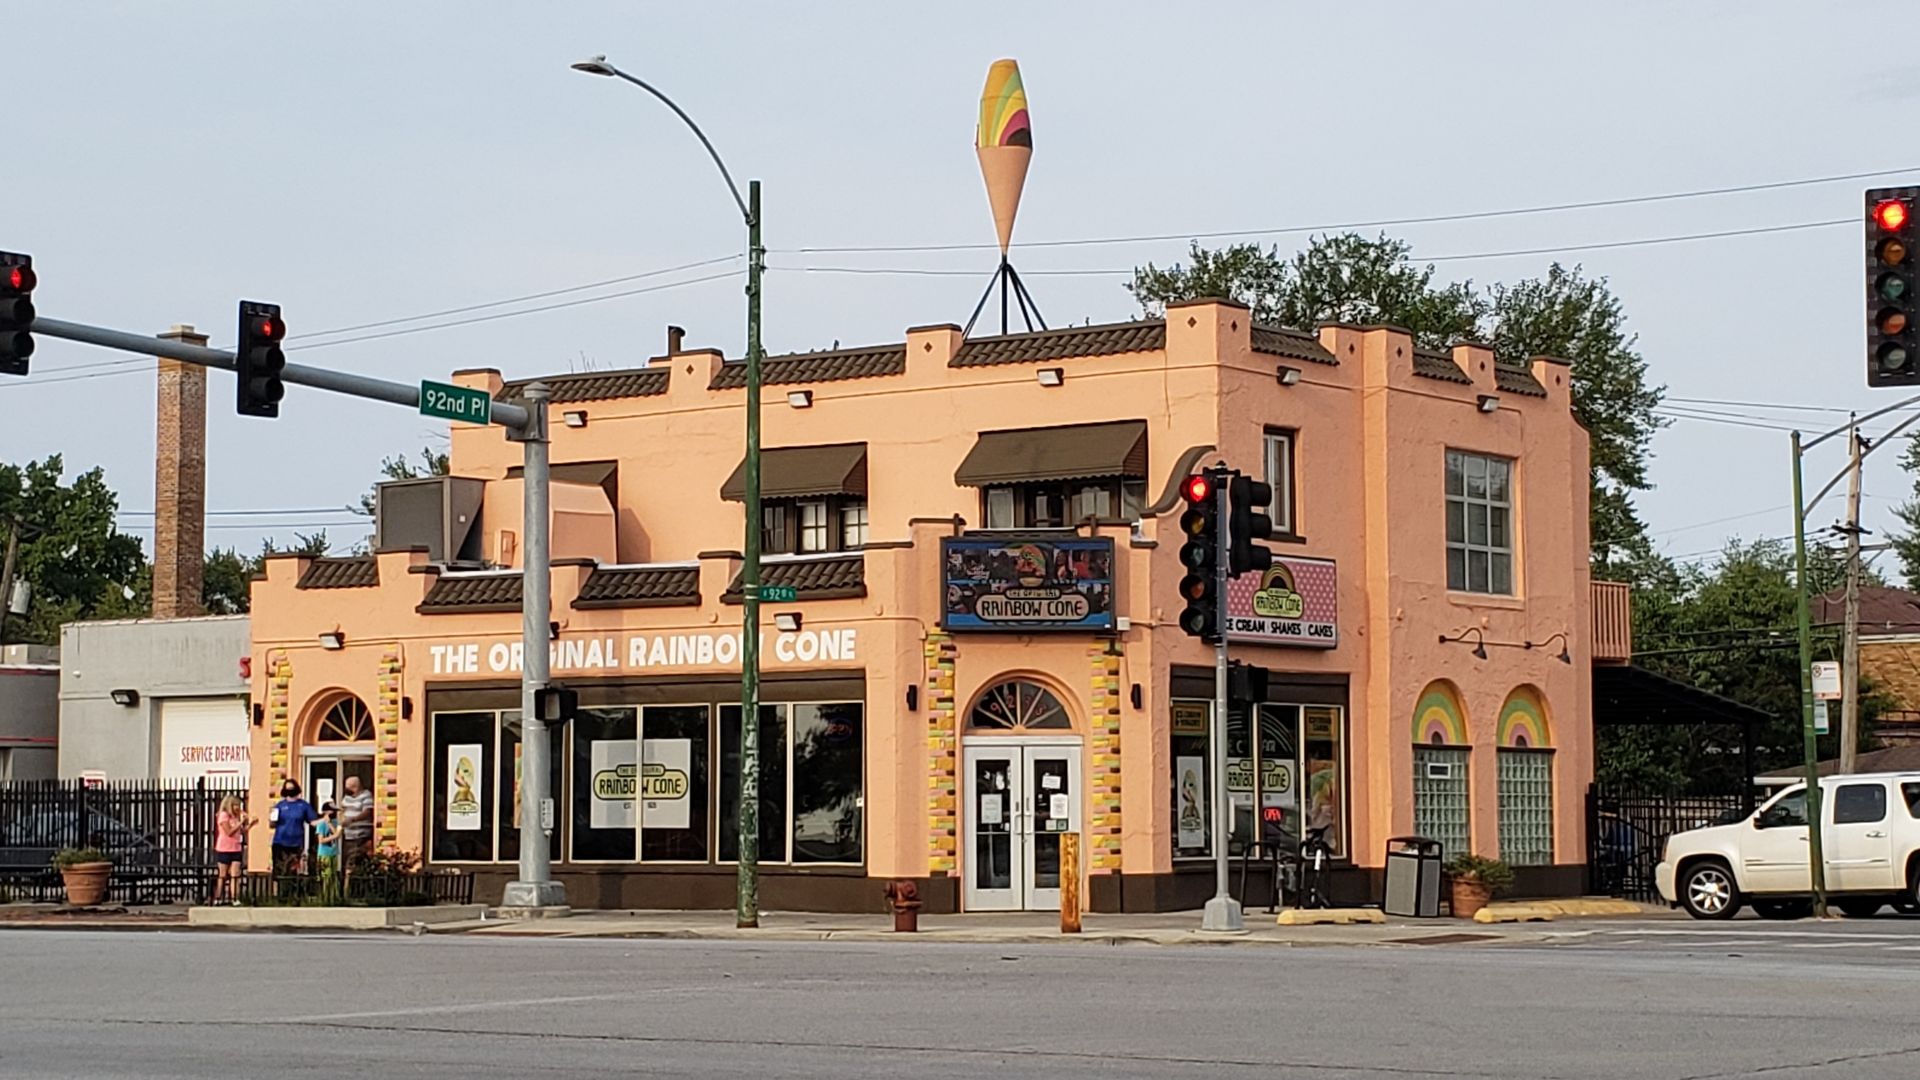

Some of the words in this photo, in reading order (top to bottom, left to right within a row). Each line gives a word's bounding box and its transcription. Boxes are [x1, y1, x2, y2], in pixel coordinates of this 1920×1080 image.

[426, 389, 466, 413] 92nd
[471, 397, 485, 417] Pl
[982, 601, 1041, 616] RAINBOW
[1047, 601, 1084, 616] CONE
[1236, 619, 1265, 633] CREAM
[1270, 621, 1301, 635] SHAKES
[1308, 624, 1333, 637] CAKES
[430, 644, 479, 673] THE
[488, 638, 618, 672] ORINAL
[775, 629, 857, 662] CONE
[181, 746, 212, 762] SERVICE
[653, 779, 682, 795] CONE
